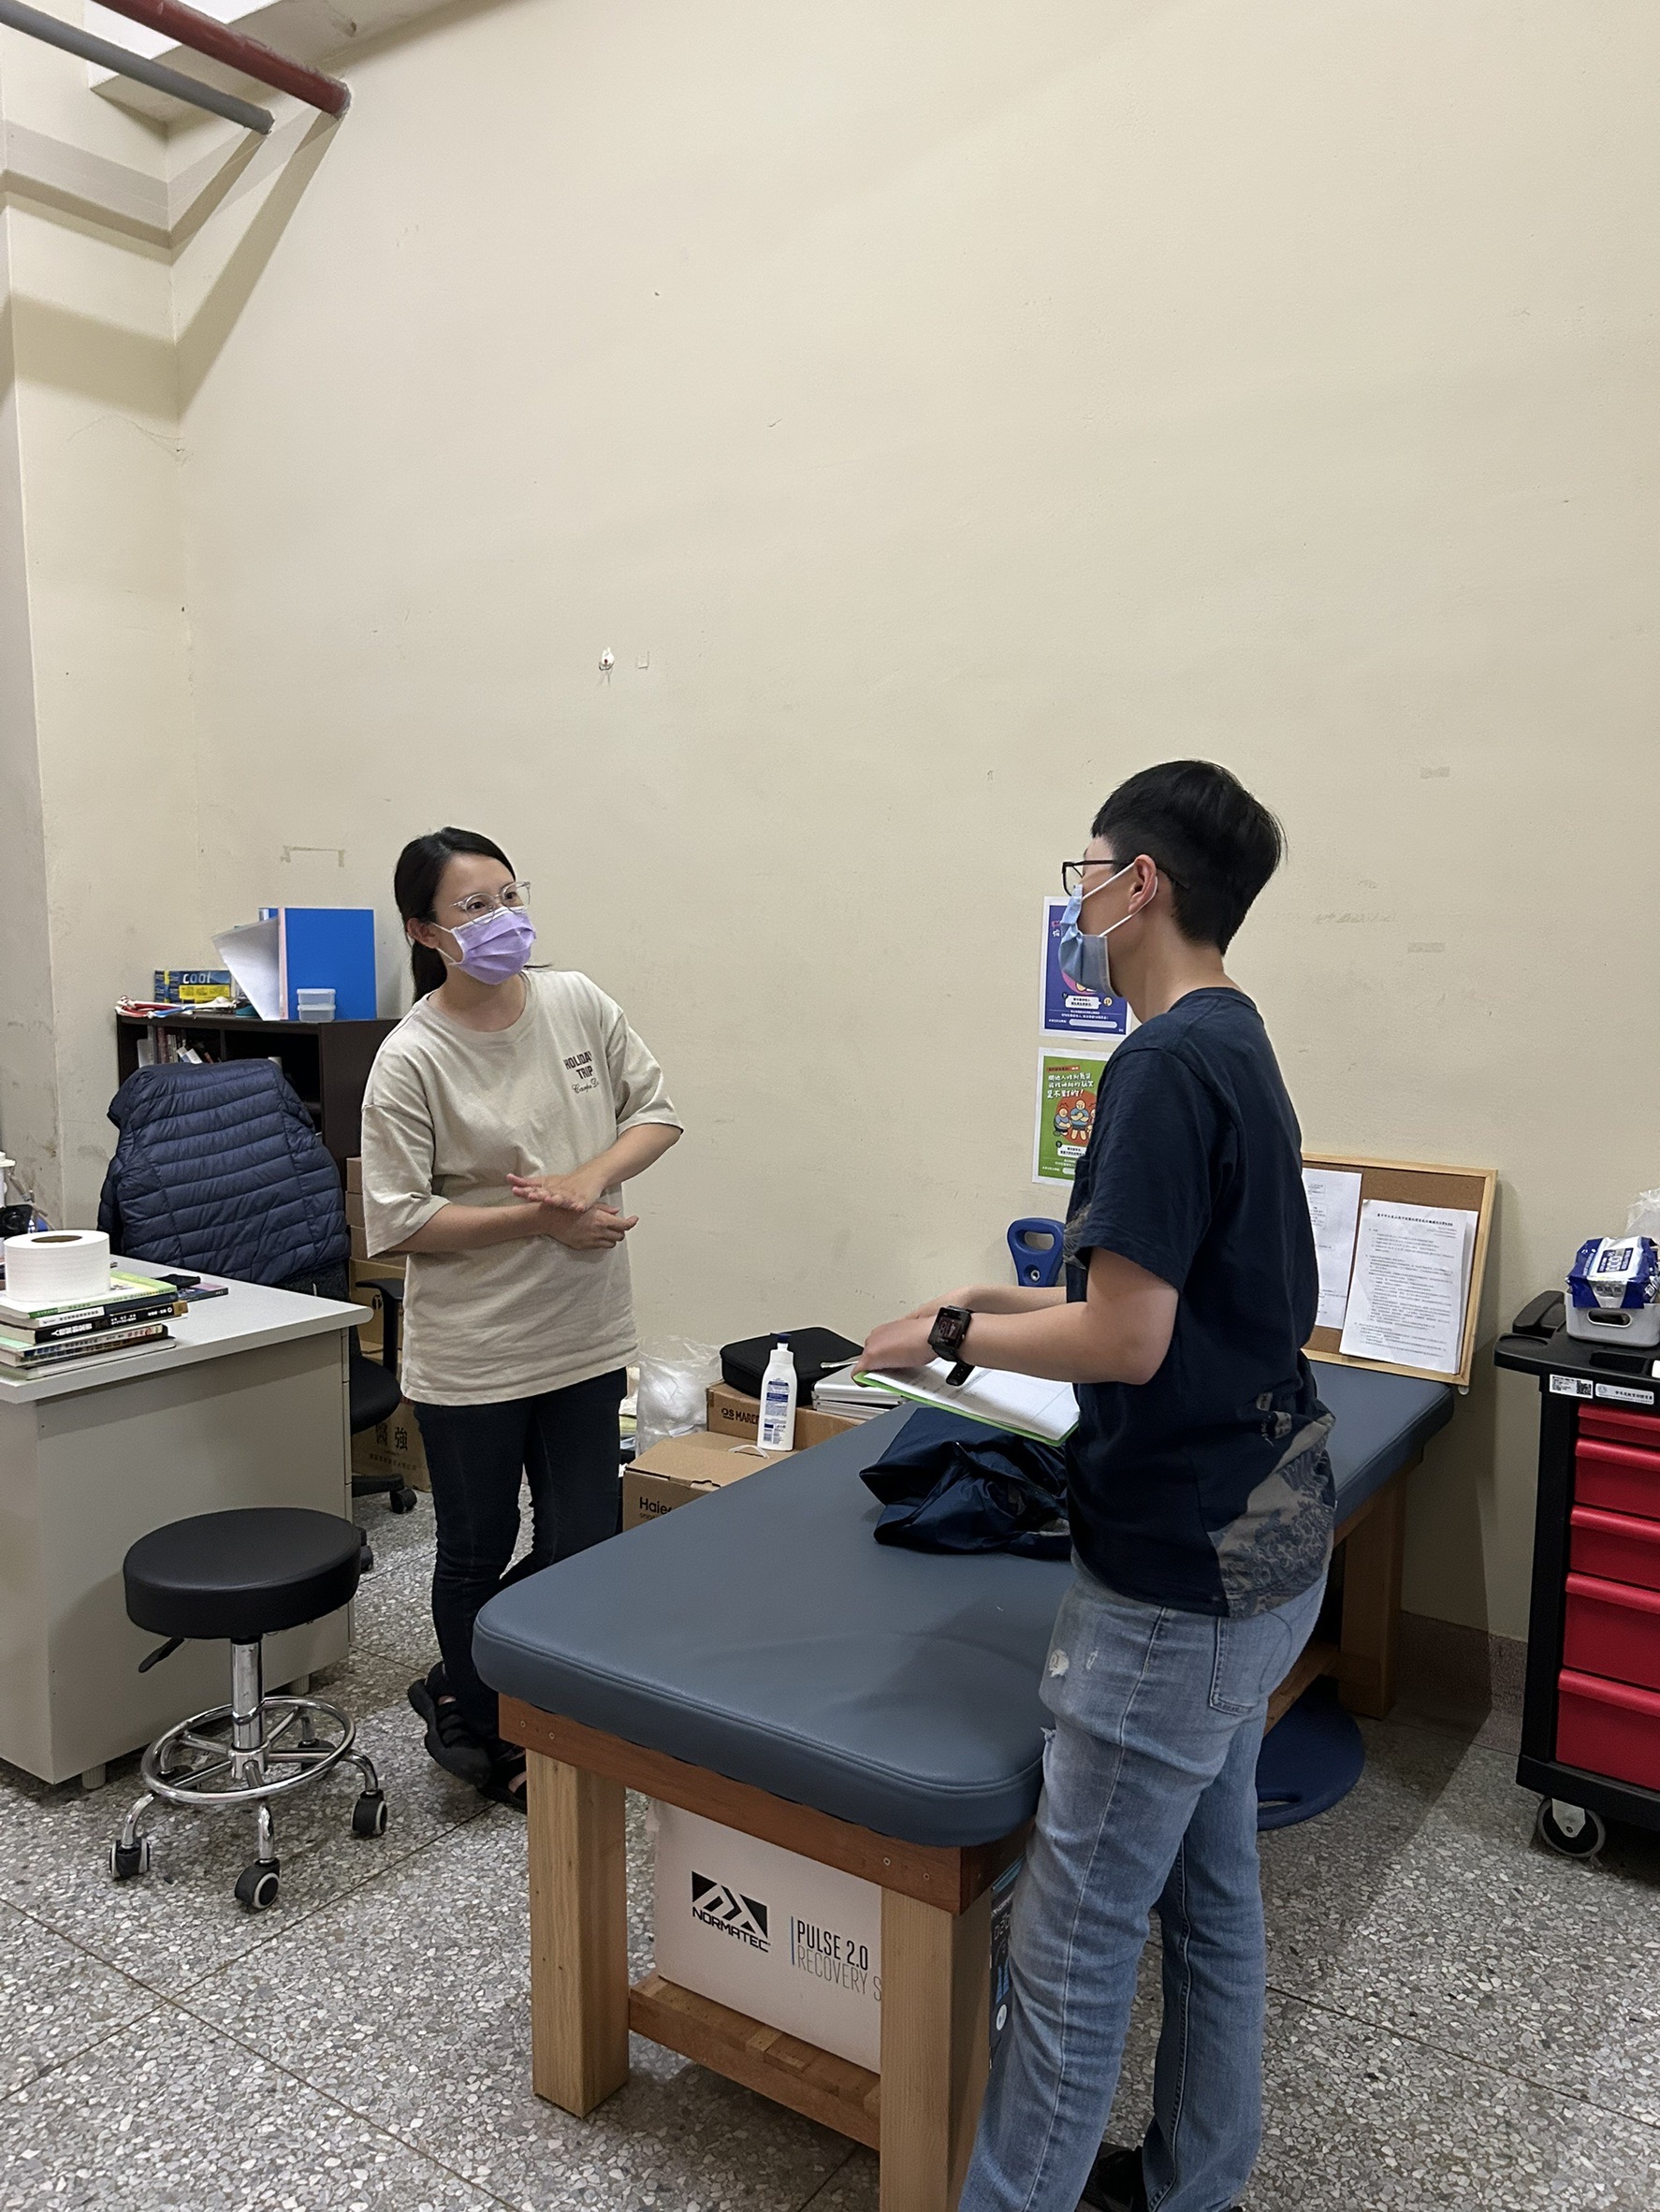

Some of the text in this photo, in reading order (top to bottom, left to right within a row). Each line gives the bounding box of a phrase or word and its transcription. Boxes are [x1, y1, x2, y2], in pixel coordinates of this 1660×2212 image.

[575, 1066, 592, 1079] TRIP
[692, 1906, 770, 1954] NORMATEC
[797, 1919, 869, 1972] PULSE 2.0
[797, 1943, 868, 1995] RECOVERY
